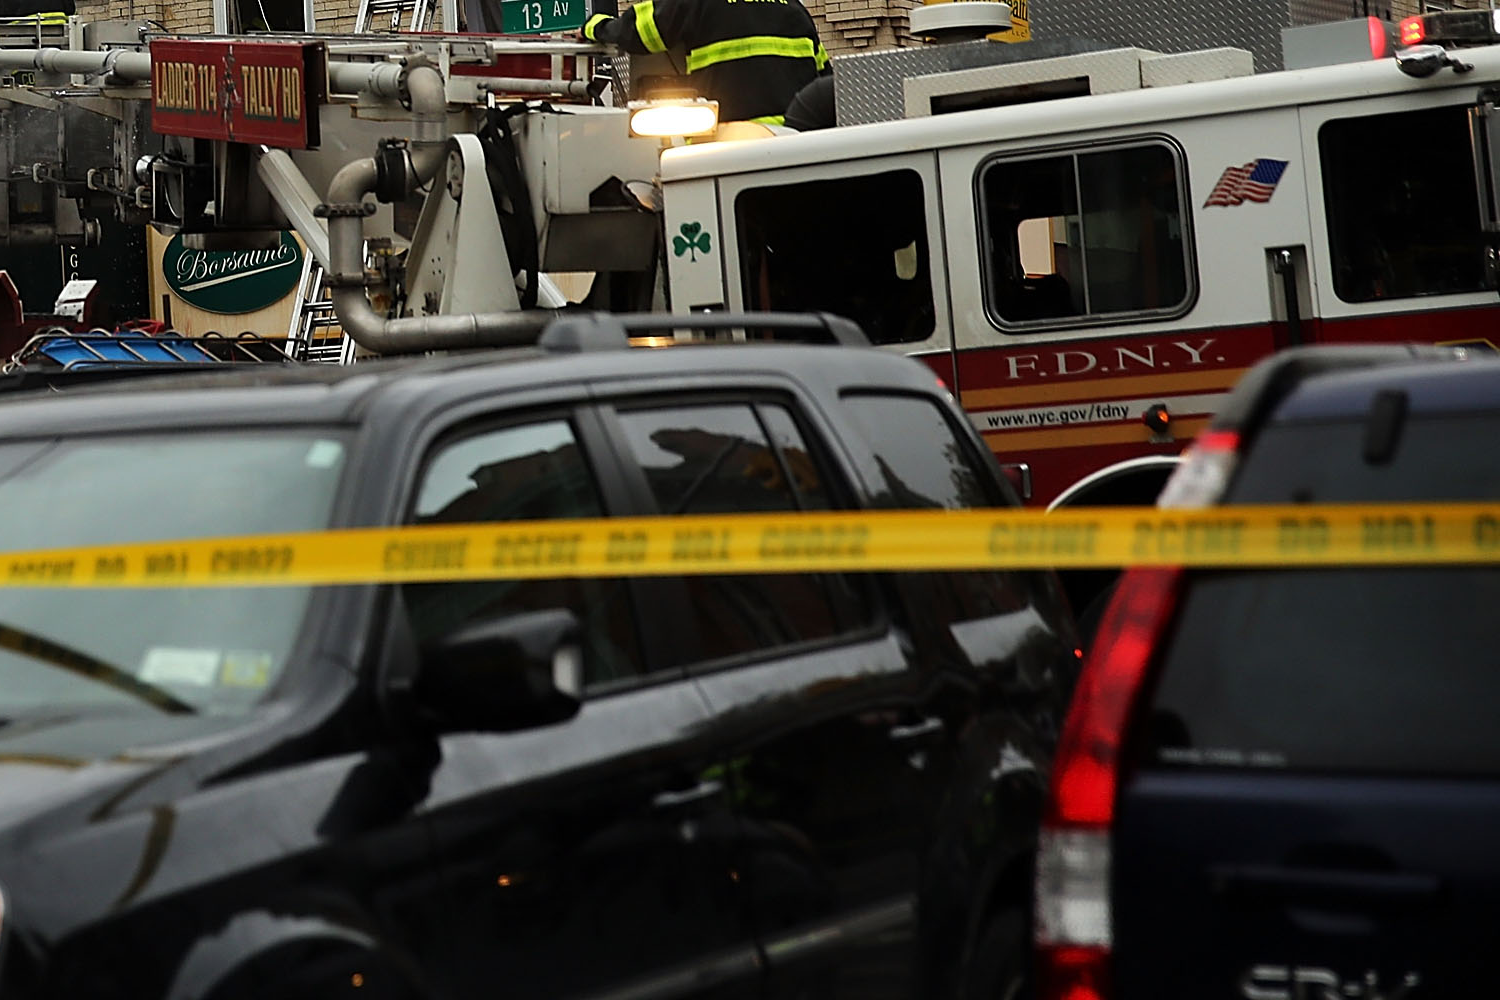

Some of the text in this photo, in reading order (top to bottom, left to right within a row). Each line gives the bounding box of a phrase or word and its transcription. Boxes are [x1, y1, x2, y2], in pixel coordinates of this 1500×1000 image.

[521, 0, 569, 30] 13 Av
[155, 62, 218, 112] LADDER 114
[241, 65, 301, 121] TALLY HO
[1004, 339, 1227, 380] F.D.N.Y.
[987, 403, 1130, 429] www.nyc.gov/fdny
